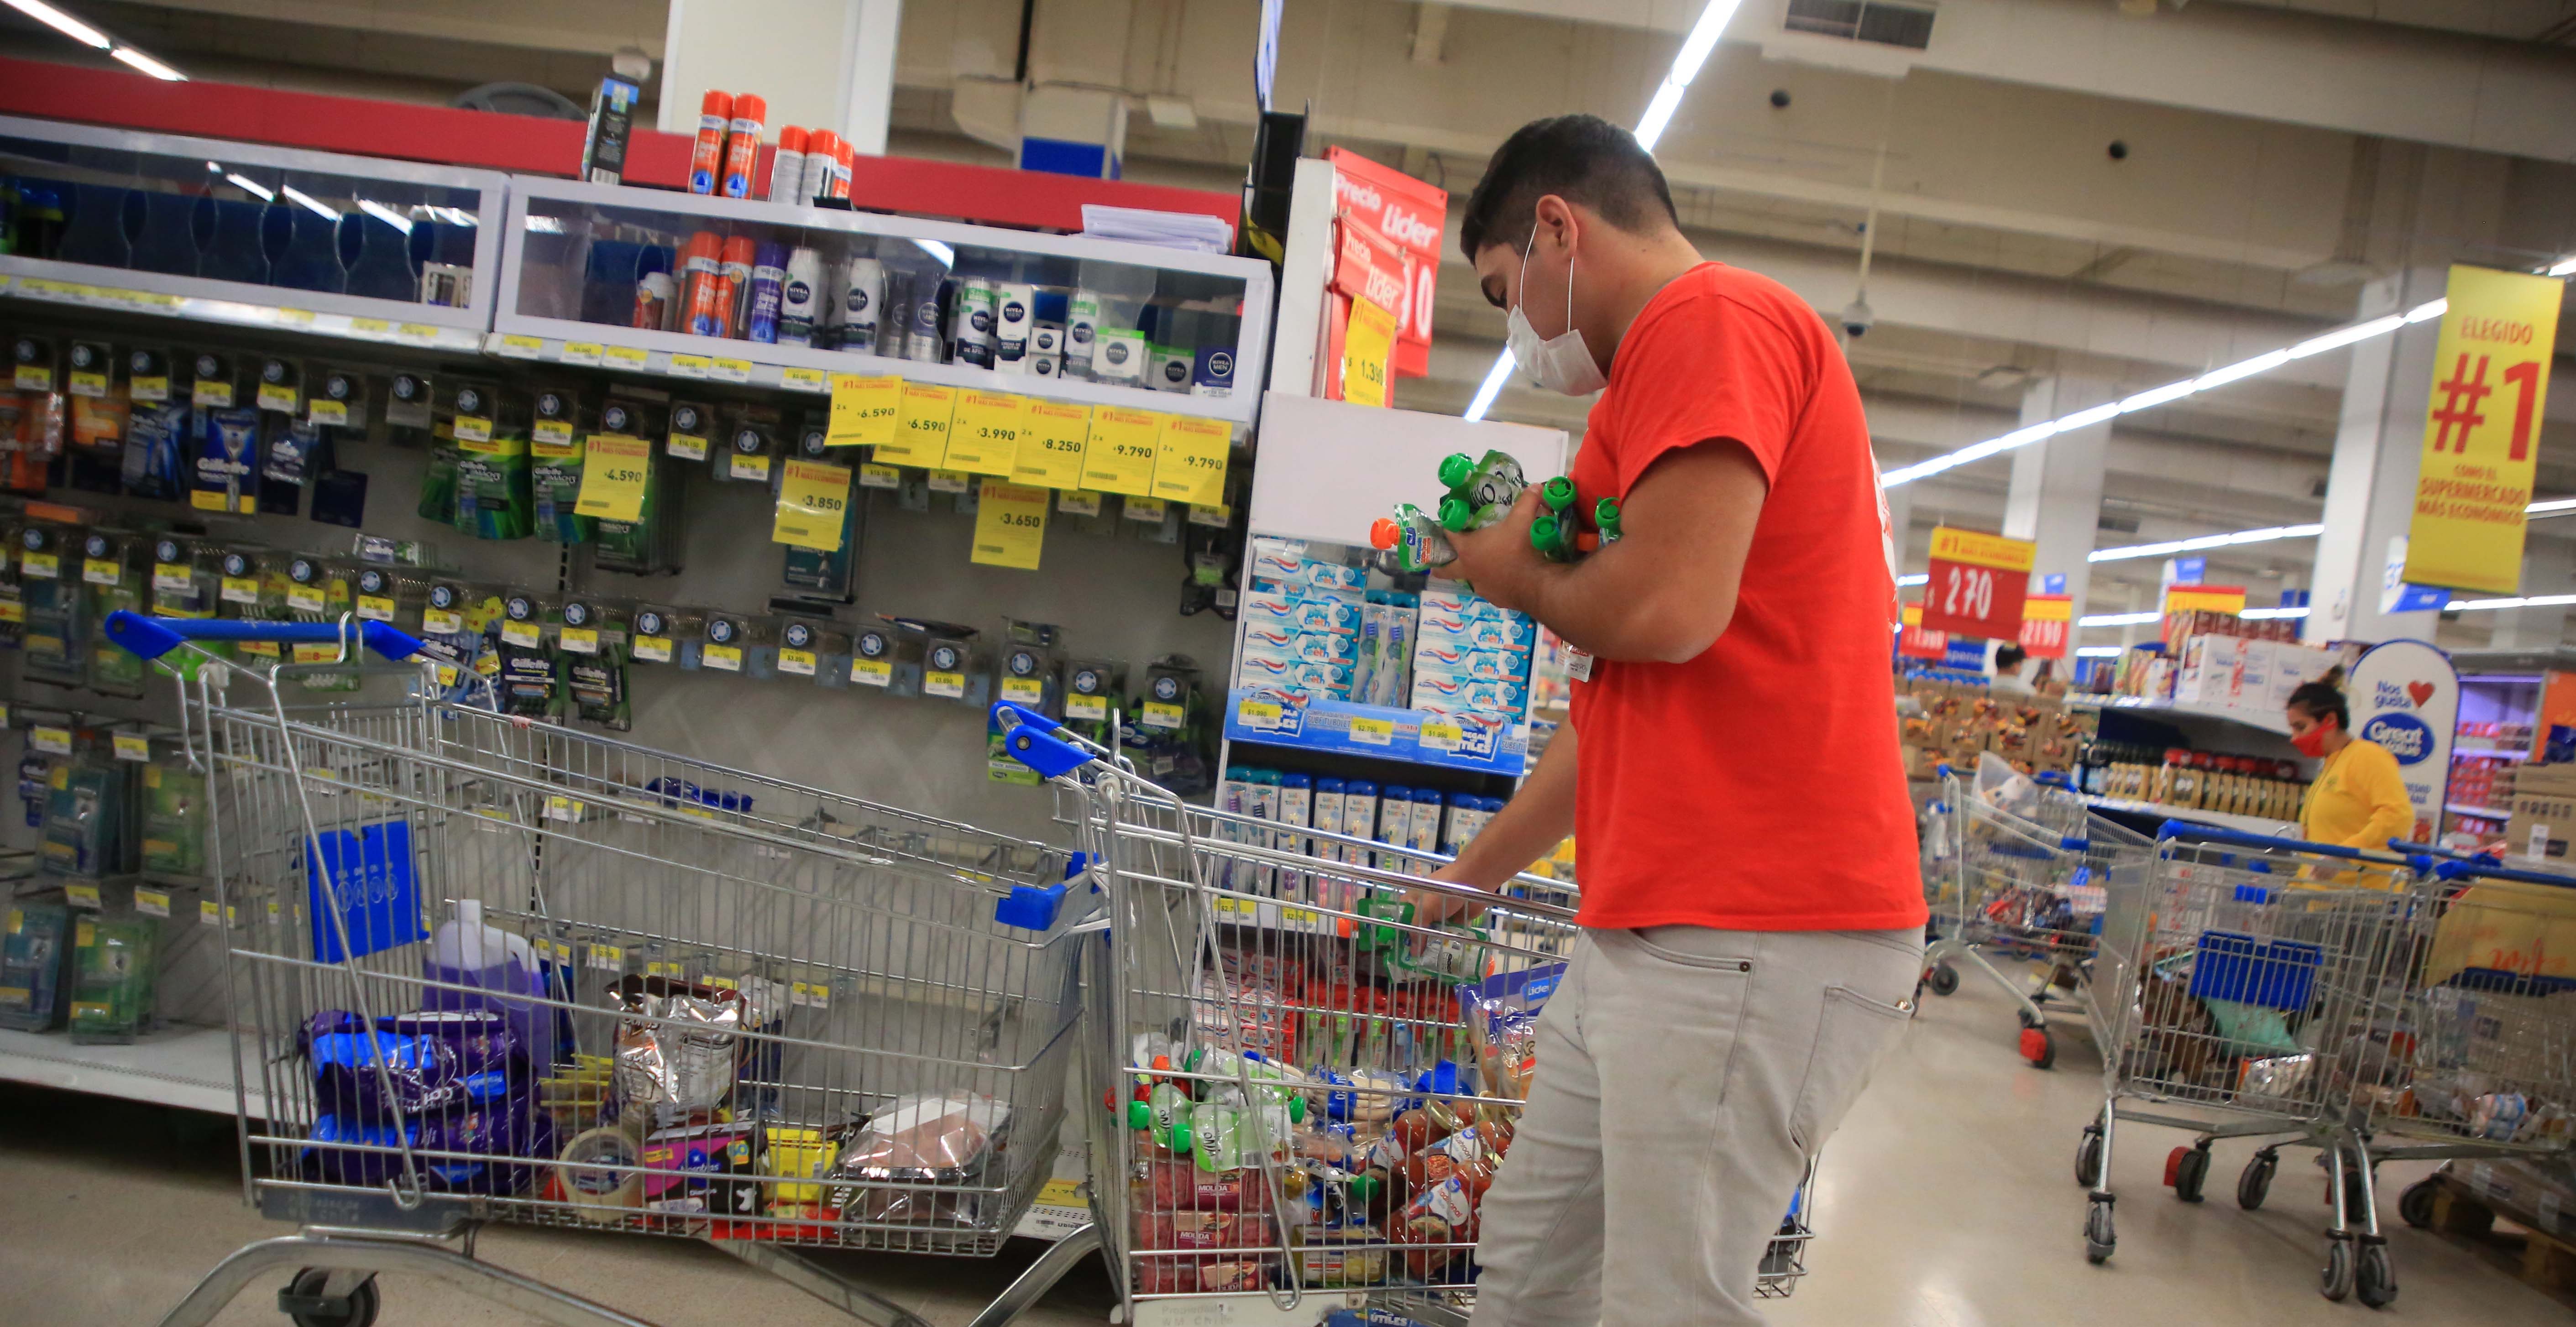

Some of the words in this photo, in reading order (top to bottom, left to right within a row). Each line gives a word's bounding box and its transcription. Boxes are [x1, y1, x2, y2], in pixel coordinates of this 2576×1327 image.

[1335, 173, 1381, 211] Precio
[1346, 228, 1371, 267] Precio
[2461, 316, 2534, 345] ELEGIDO
[843, 380, 853, 388] #1
[966, 395, 977, 404] #1
[1031, 405, 1042, 415] #1
[2432, 352, 2540, 462] #1
[1102, 412, 1113, 421] #1
[1171, 421, 1183, 430] #1
[589, 441, 601, 452] #1
[197, 457, 250, 475] Gillette
[786, 466, 801, 479] #1
[983, 485, 997, 499] #1
[2420, 477, 2527, 506] SUPERMERCADO
[2418, 498, 2446, 517] MÁS
[2448, 503, 2524, 527] ECONÓMICO
[1944, 566, 1993, 621] 270
[511, 658, 550, 669] Gillette
[573, 666, 607, 679] Gillette
[2377, 680, 2401, 695] Nos
[2374, 695, 2412, 709] gusta
[2370, 721, 2424, 744] Great
